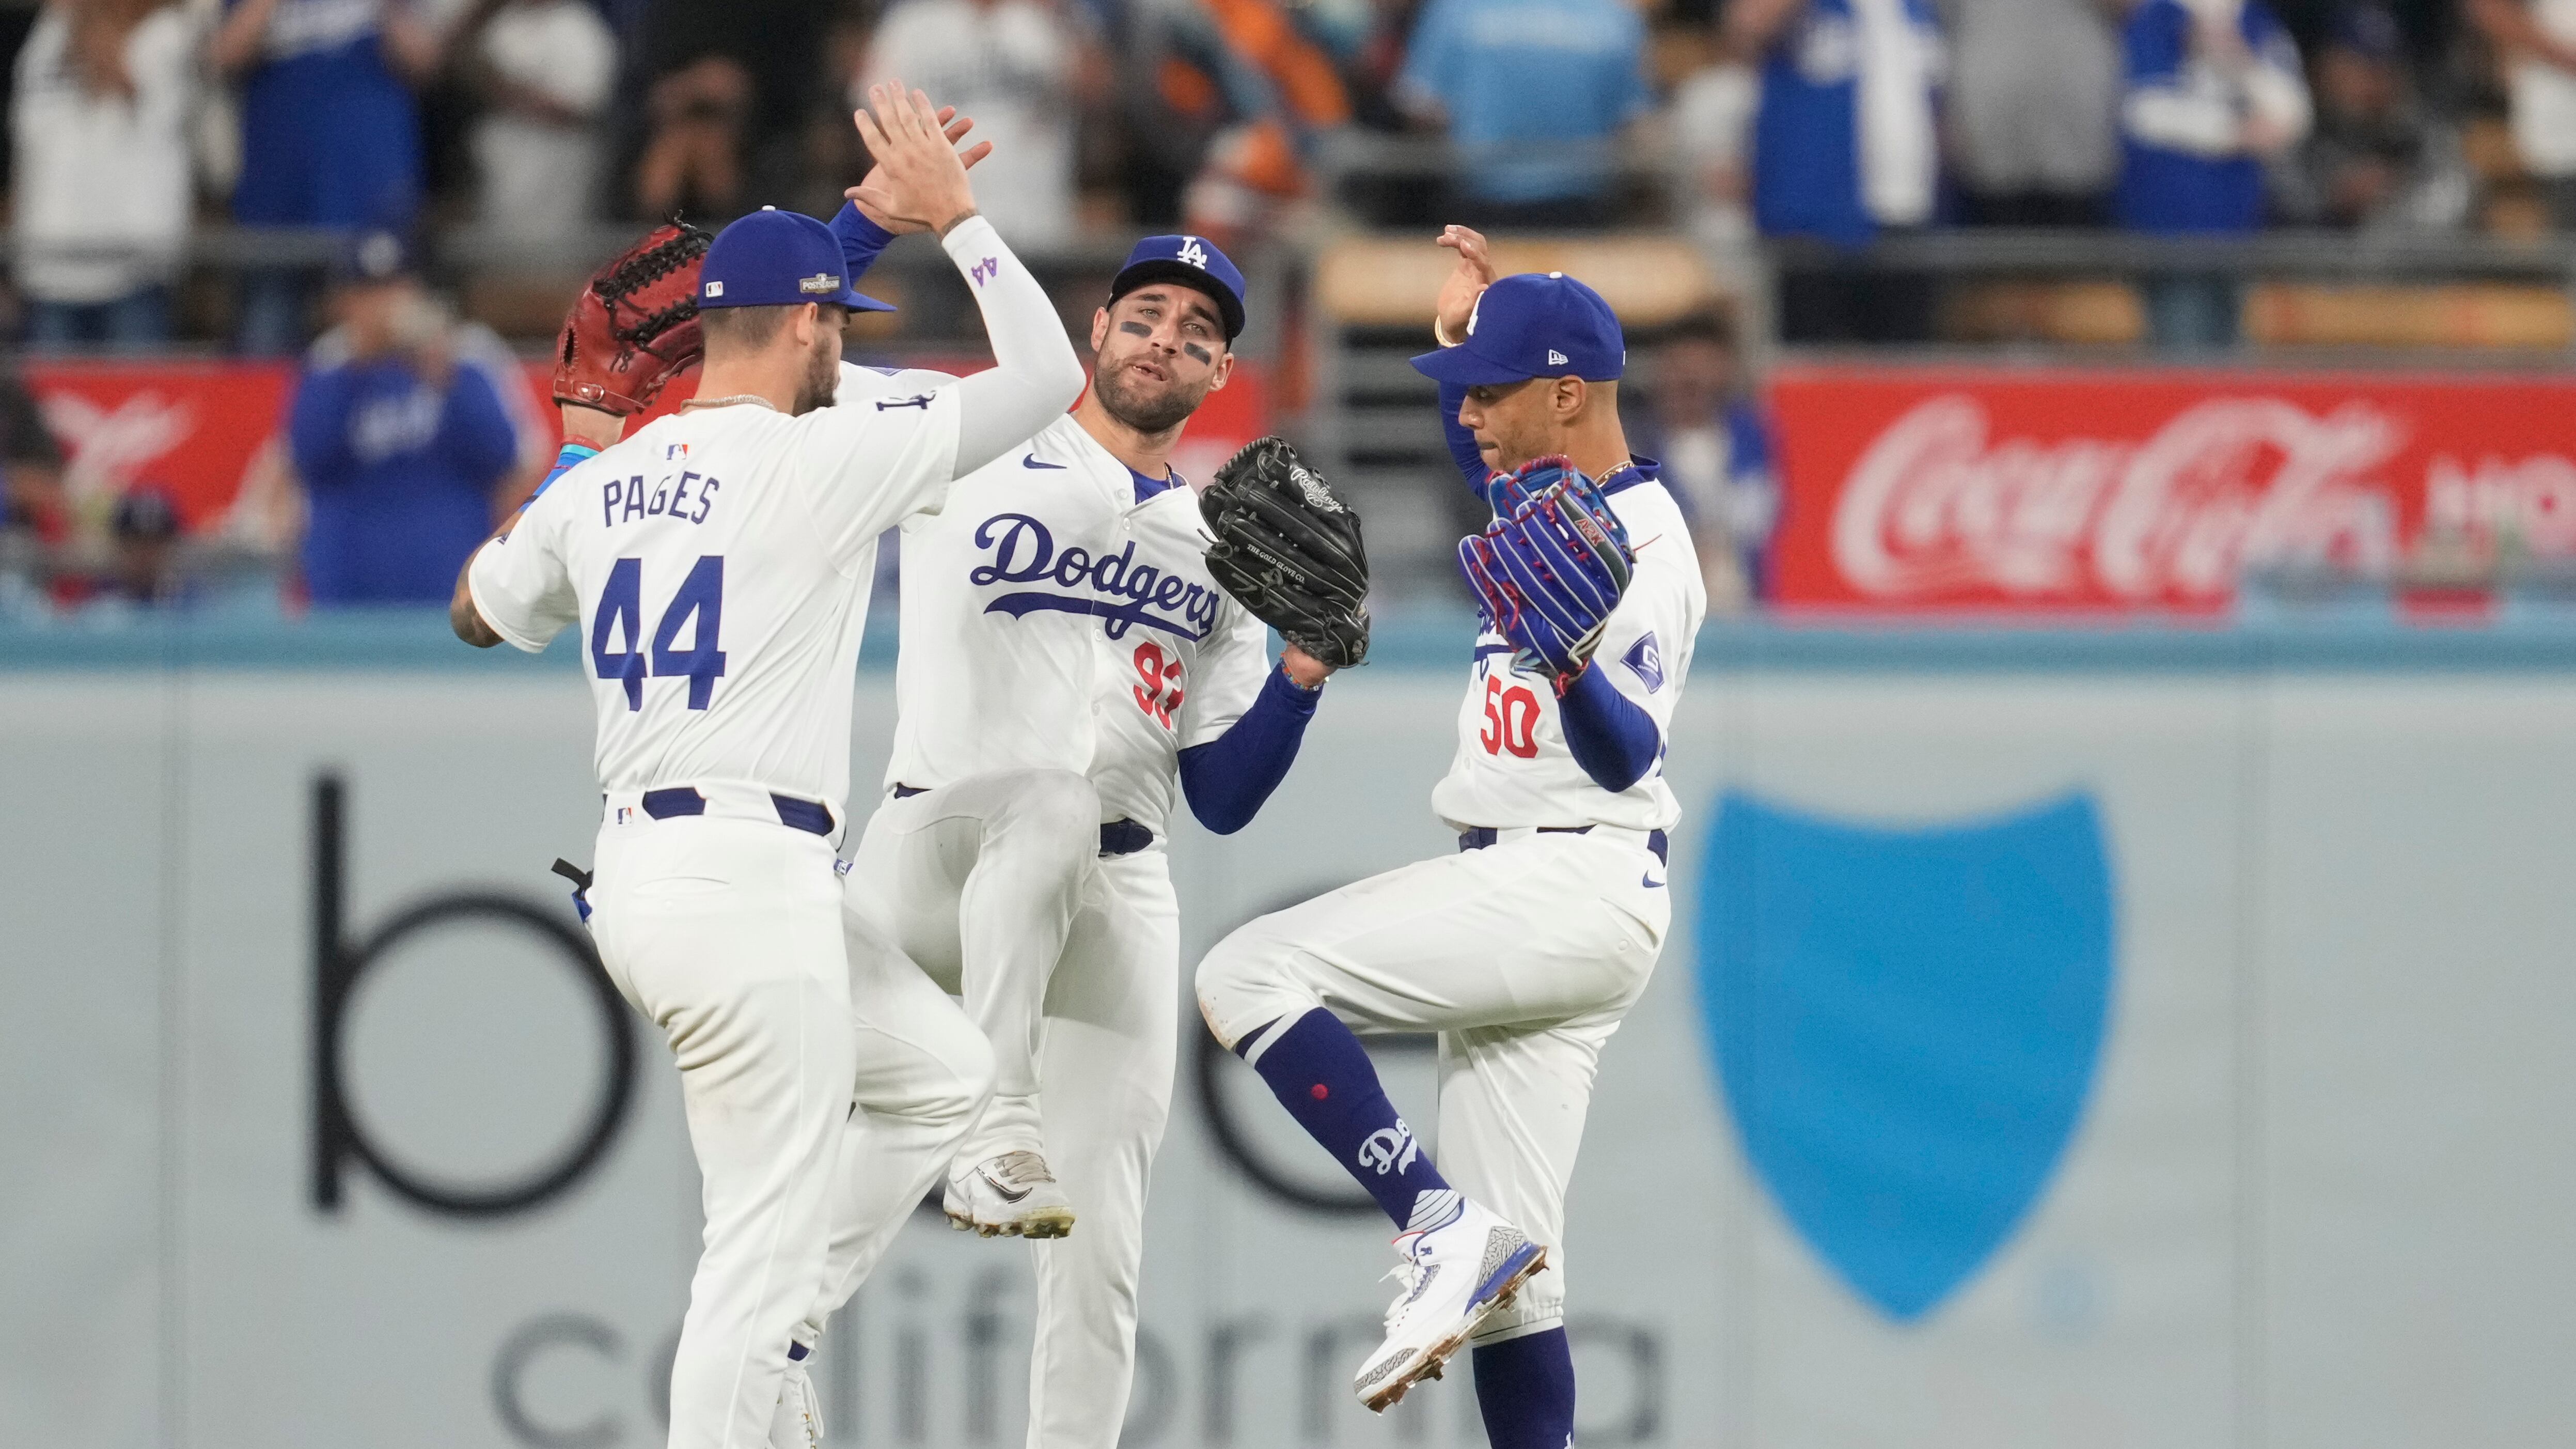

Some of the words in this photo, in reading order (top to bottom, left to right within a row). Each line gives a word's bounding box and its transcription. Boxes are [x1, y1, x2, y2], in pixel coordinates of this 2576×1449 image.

[1177, 237, 1207, 269] LA
[604, 471, 720, 528] PAGES
[1291, 468, 1344, 513] Rawlings
[1575, 518, 1605, 547] A2K
[970, 512, 1220, 640] Dodgers
[1247, 543, 1260, 555] THE
[1259, 552, 1277, 564] GOLD
[1276, 562, 1296, 577] GLOVE
[1295, 573, 1305, 584] CO.
[592, 555, 727, 711] 44
[1133, 641, 1184, 730] 93
[1480, 674, 1541, 758] 50
